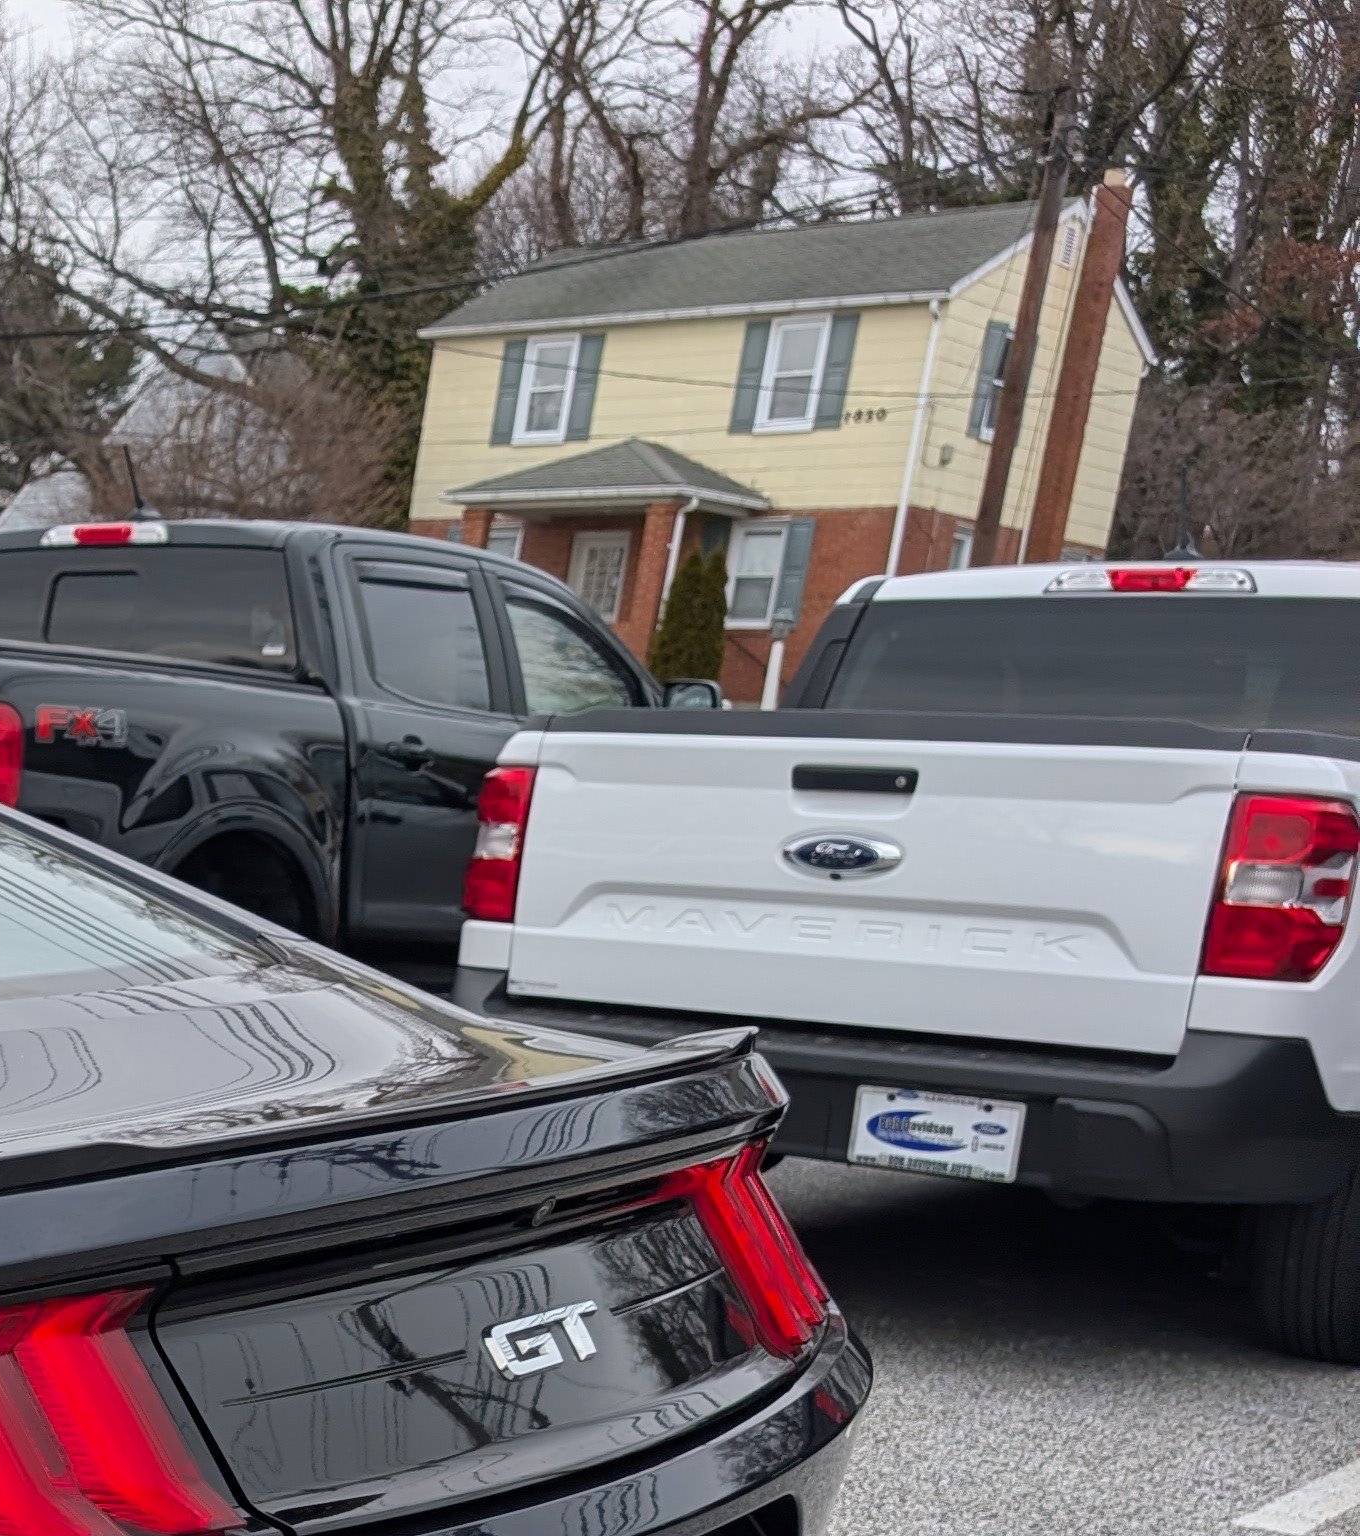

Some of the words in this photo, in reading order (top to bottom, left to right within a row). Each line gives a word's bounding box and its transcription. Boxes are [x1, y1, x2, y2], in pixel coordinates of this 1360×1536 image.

[35, 704, 128, 746] FX4
[607, 903, 1089, 962] MAVERICK
[482, 1299, 598, 1381] GT
